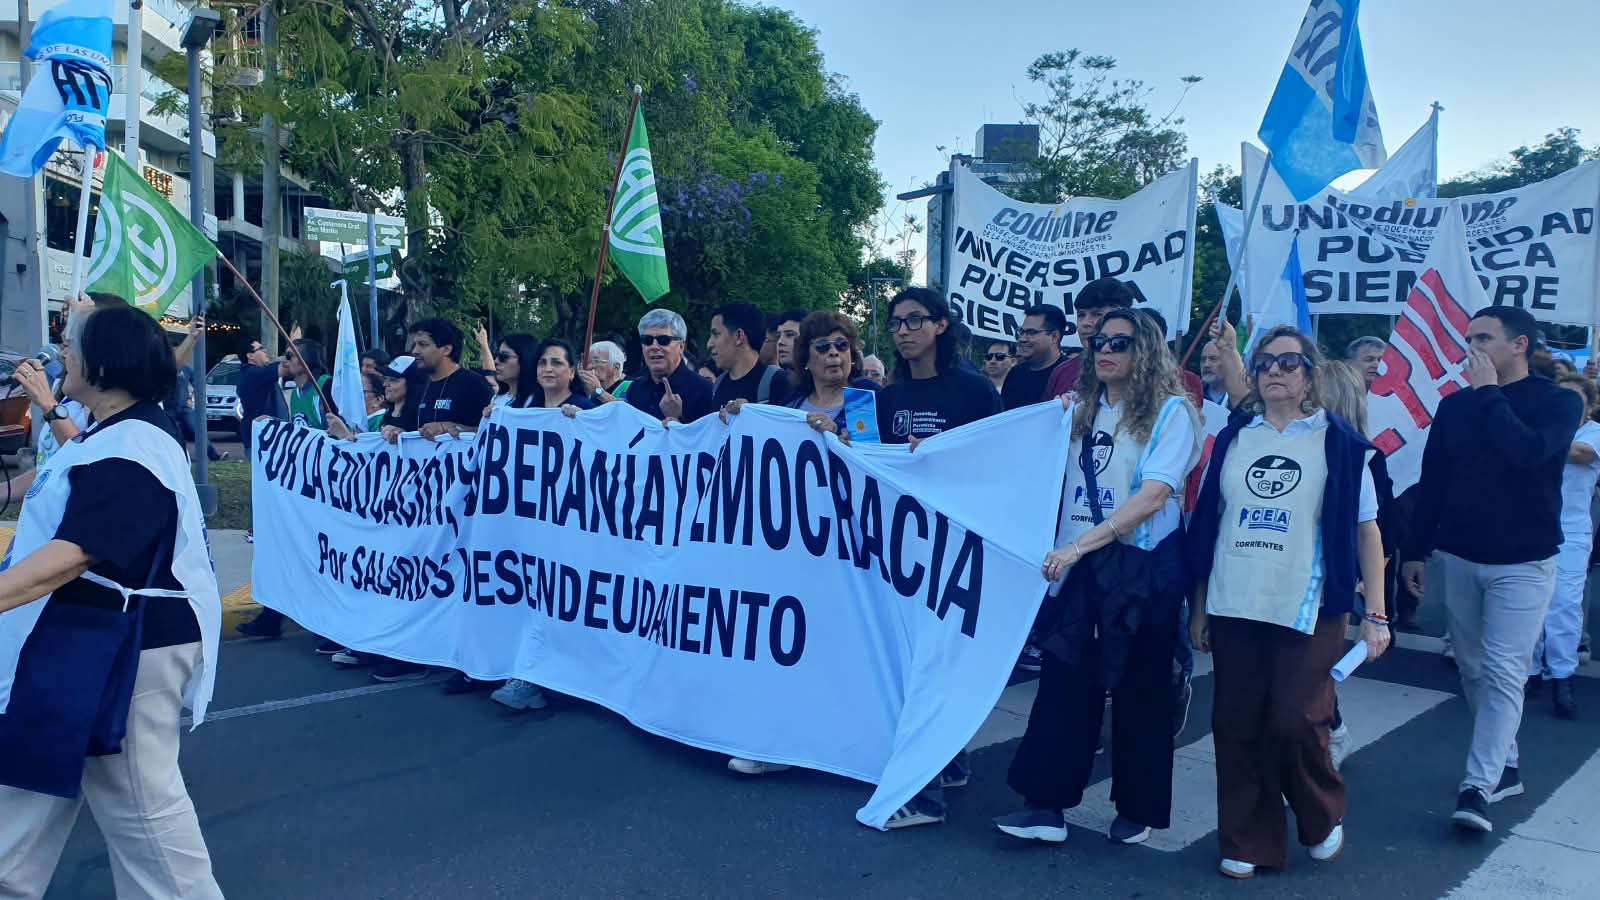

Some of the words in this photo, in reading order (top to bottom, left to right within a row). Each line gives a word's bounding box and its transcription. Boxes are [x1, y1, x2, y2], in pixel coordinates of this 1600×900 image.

[258, 419, 309, 491] POR
[301, 433, 325, 503] LA
[670, 453, 691, 547] Y
[1251, 509, 1288, 525] CEA
[318, 532, 347, 584] Por
[1235, 541, 1284, 552] CORRIENTES
